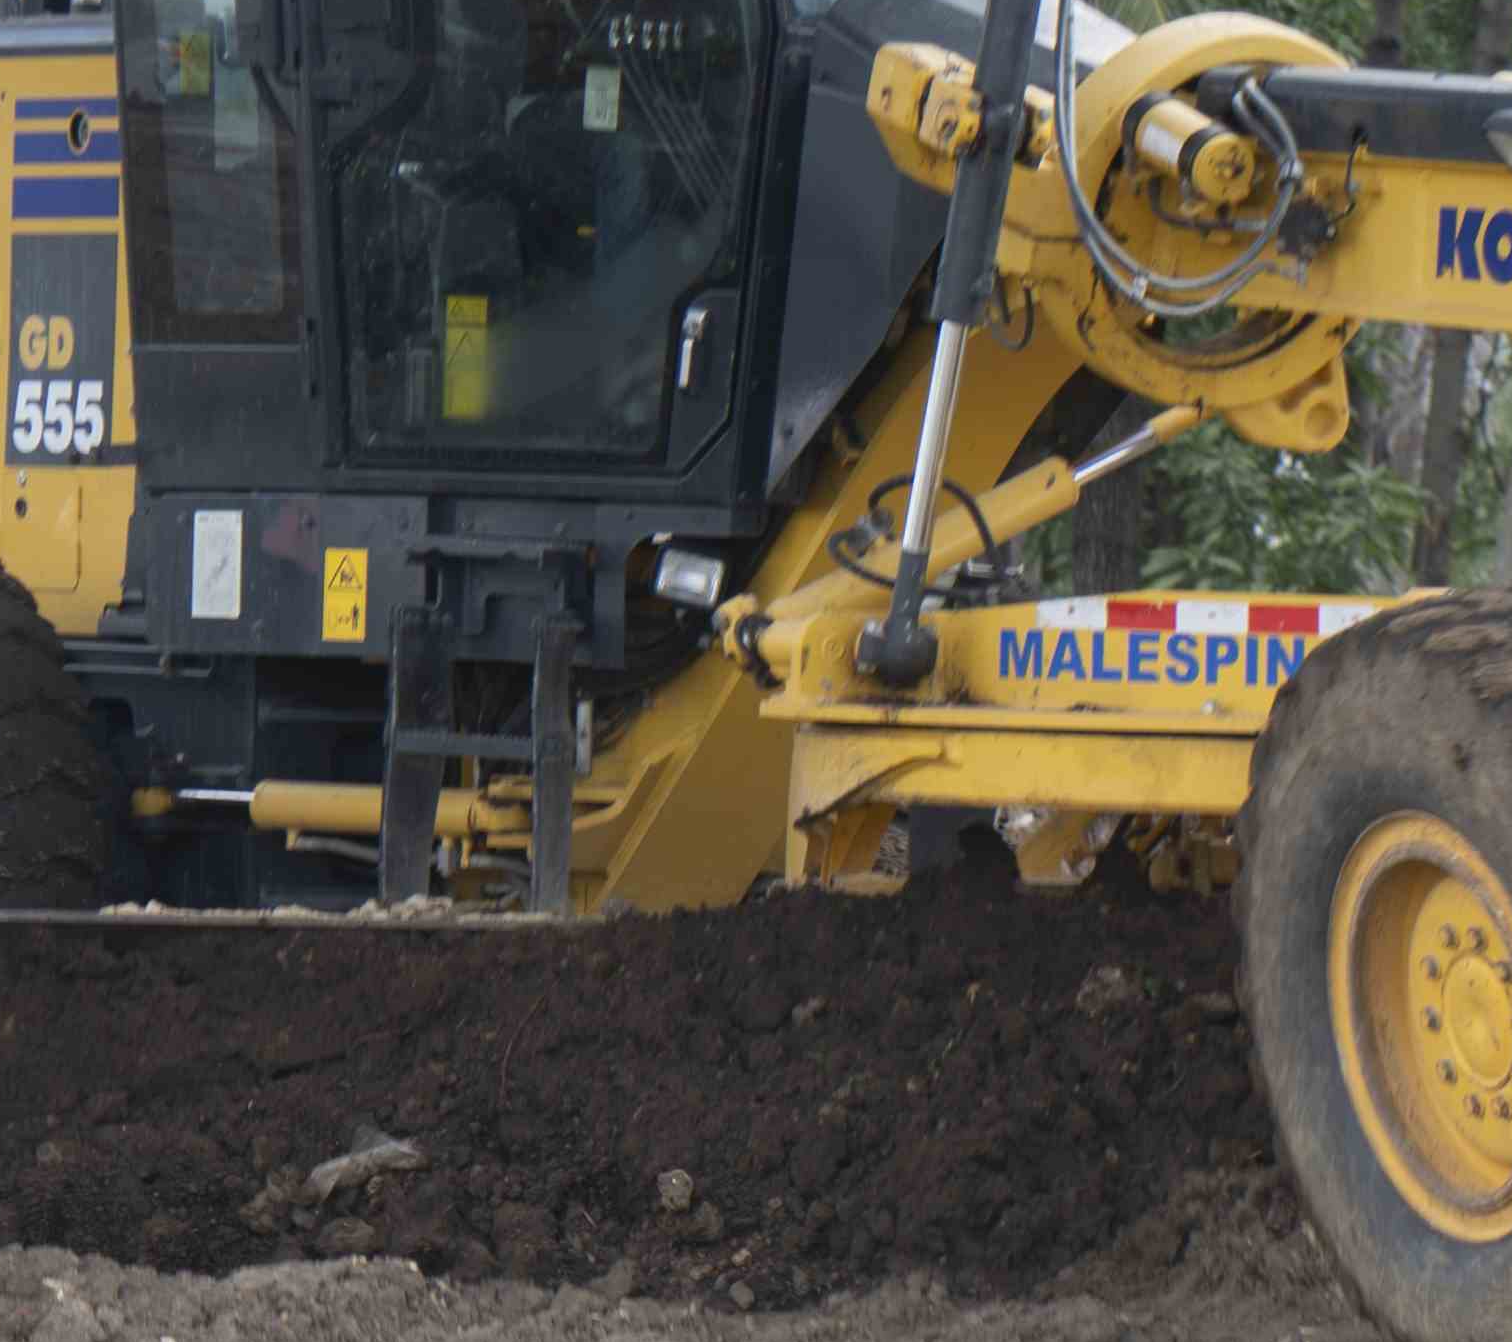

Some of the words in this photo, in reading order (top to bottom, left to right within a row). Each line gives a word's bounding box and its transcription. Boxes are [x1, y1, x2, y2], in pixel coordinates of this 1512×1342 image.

[18, 314, 75, 371] GD
[12, 379, 105, 455] 555
[999, 629, 1305, 687] MALESPIN
